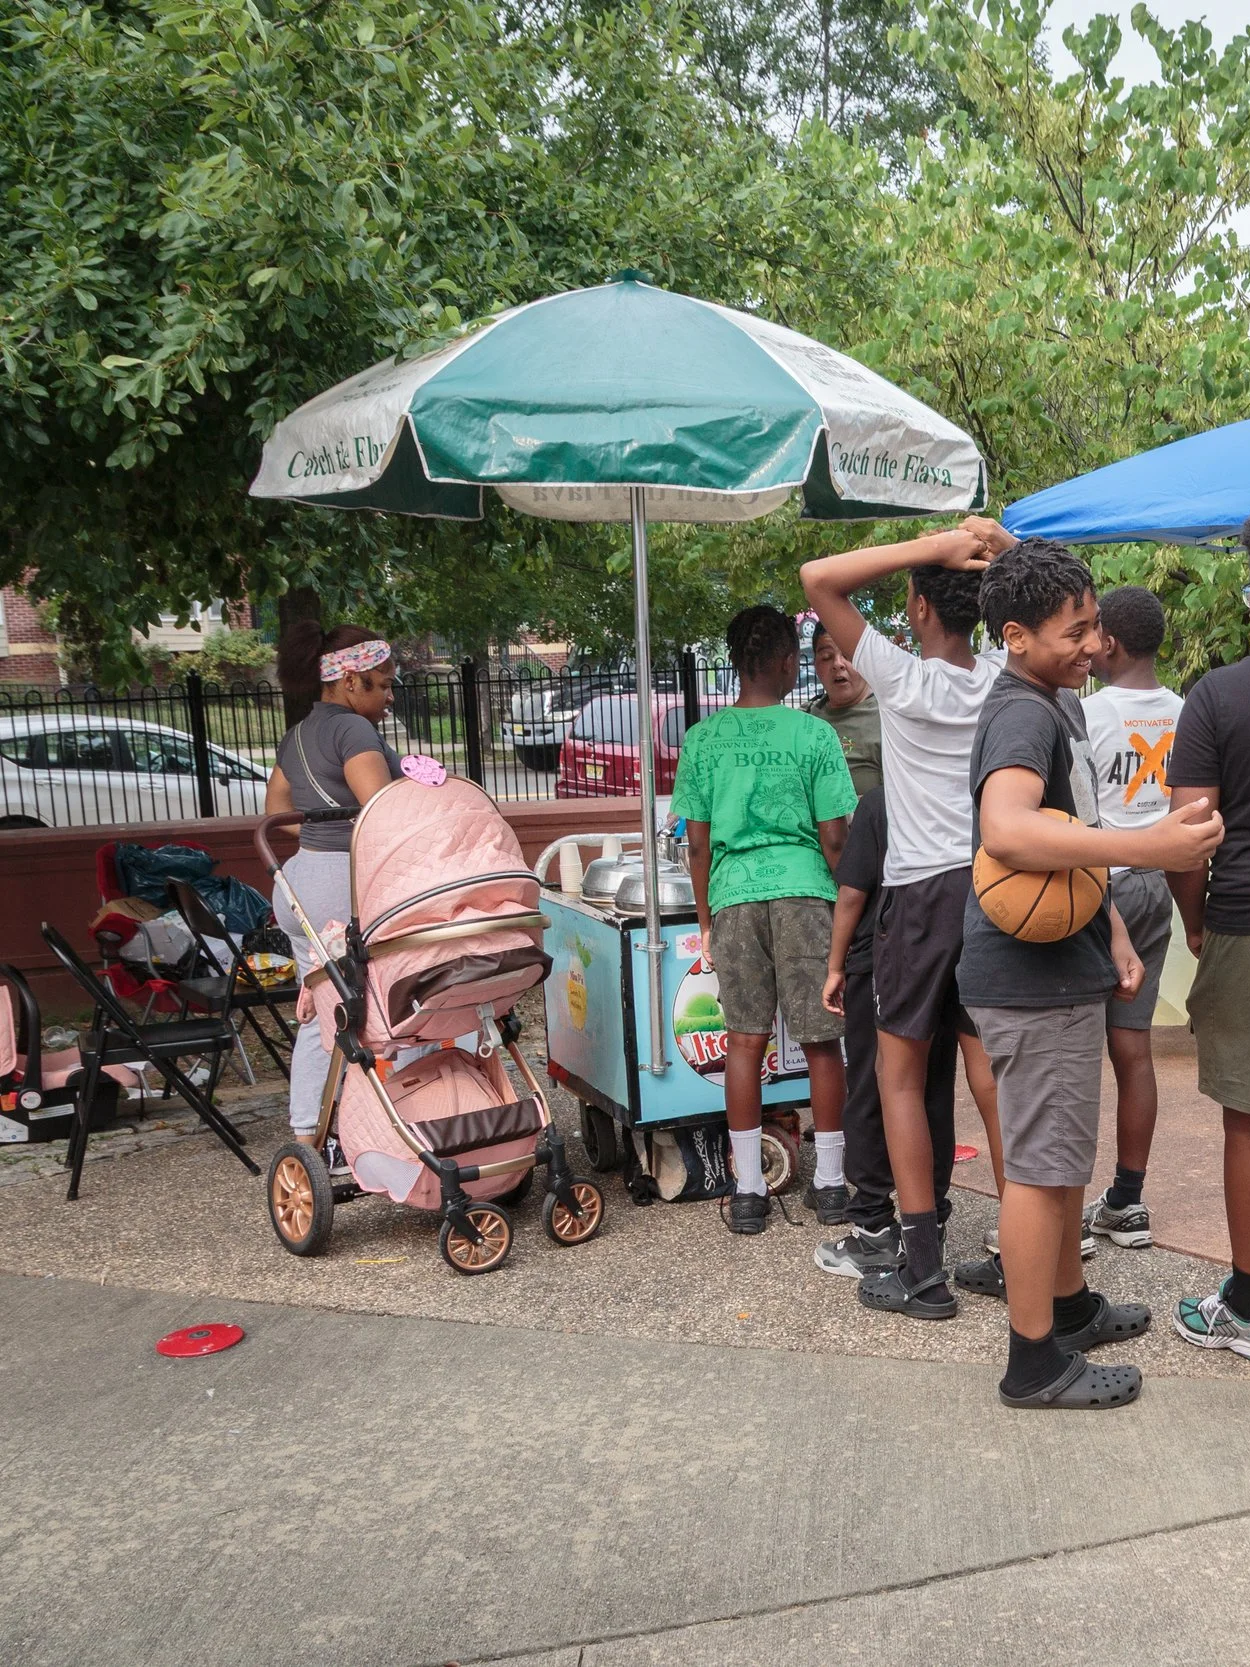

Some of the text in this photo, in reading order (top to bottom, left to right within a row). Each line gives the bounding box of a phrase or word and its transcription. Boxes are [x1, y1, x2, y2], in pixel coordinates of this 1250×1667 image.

[287, 445, 336, 479] Catch
[335, 441, 351, 470] te
[831, 442, 953, 488] Catch the Flava
[1124, 718, 1175, 728] MOTIVATED
[734, 750, 804, 768] BORN
[693, 1129, 717, 1192] ShopRite
